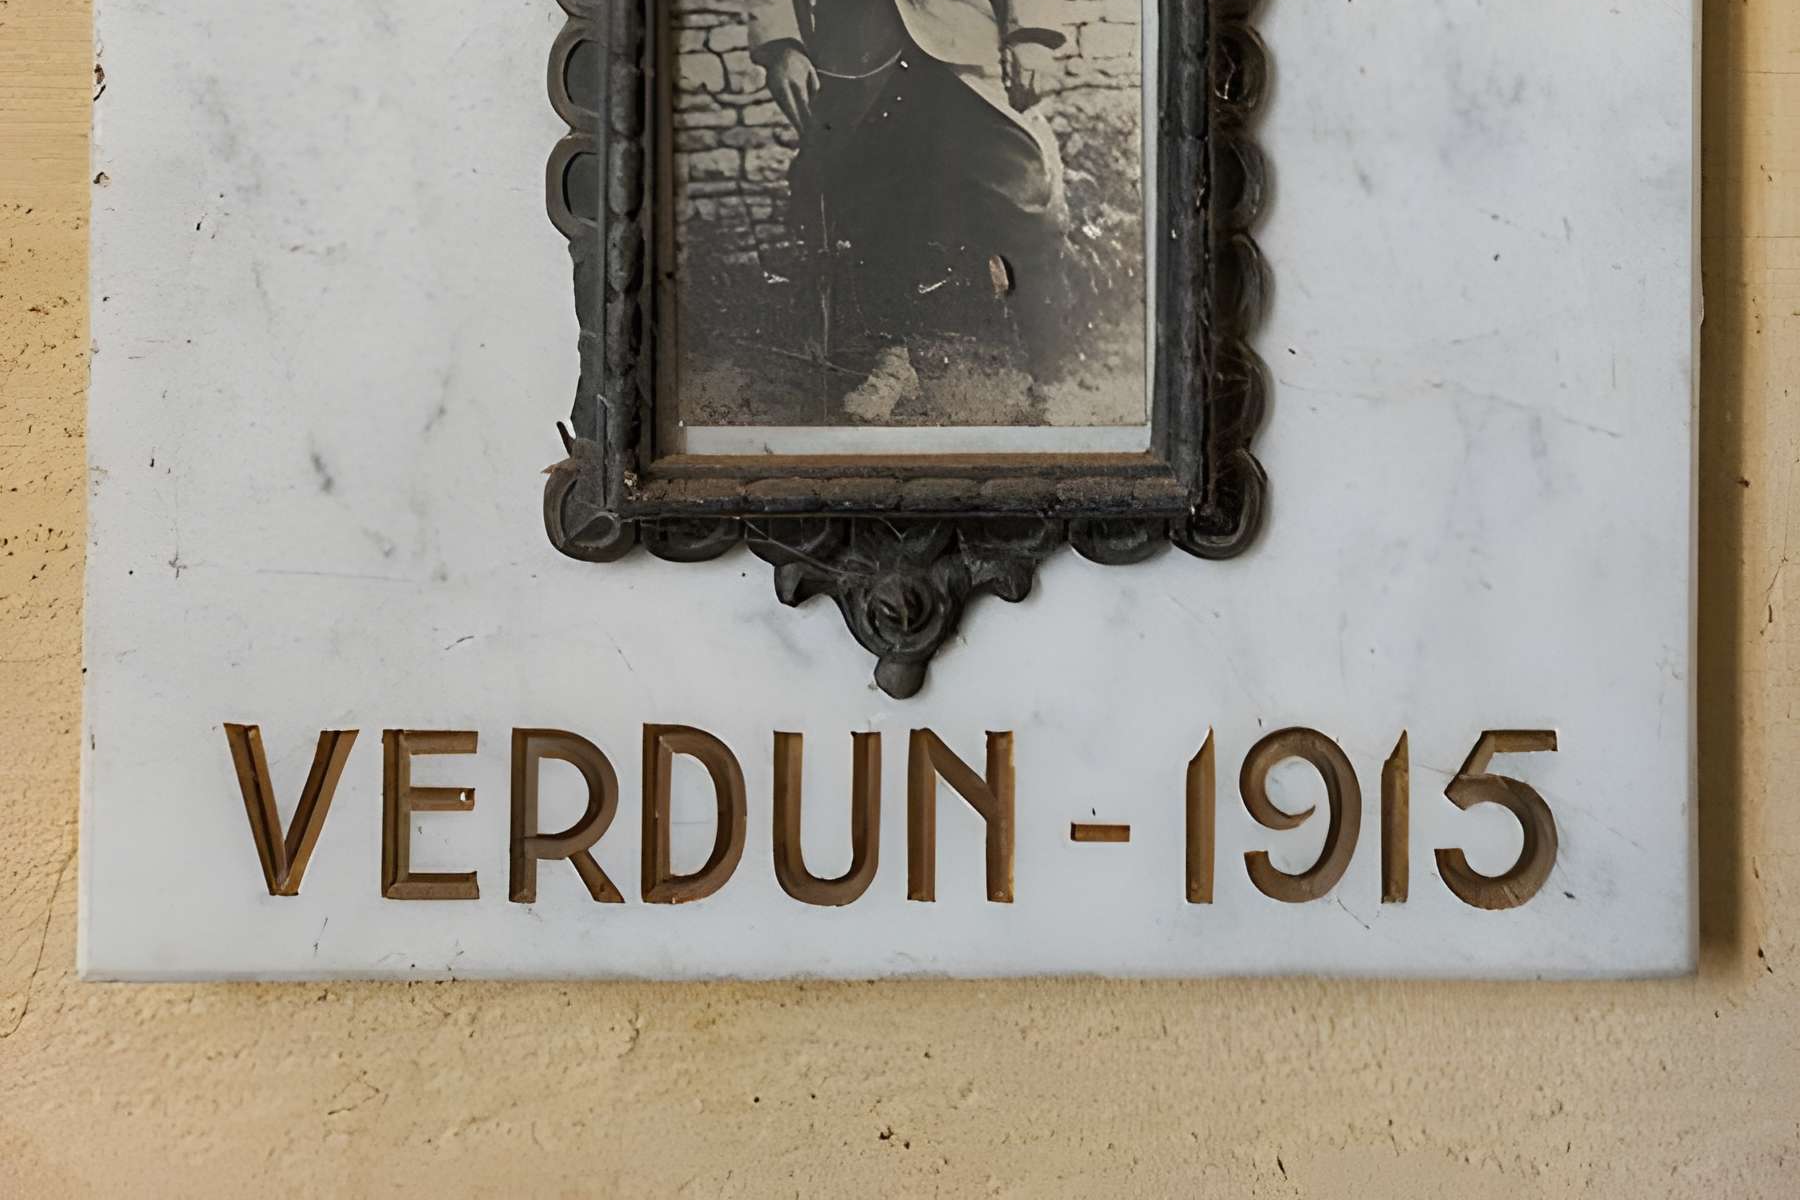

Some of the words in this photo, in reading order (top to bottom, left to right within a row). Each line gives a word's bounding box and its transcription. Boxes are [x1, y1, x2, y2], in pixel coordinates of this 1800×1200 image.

[223, 722, 1015, 907] VERDUN
[1070, 822, 1131, 843] -
[1185, 724, 1559, 911] 1915
